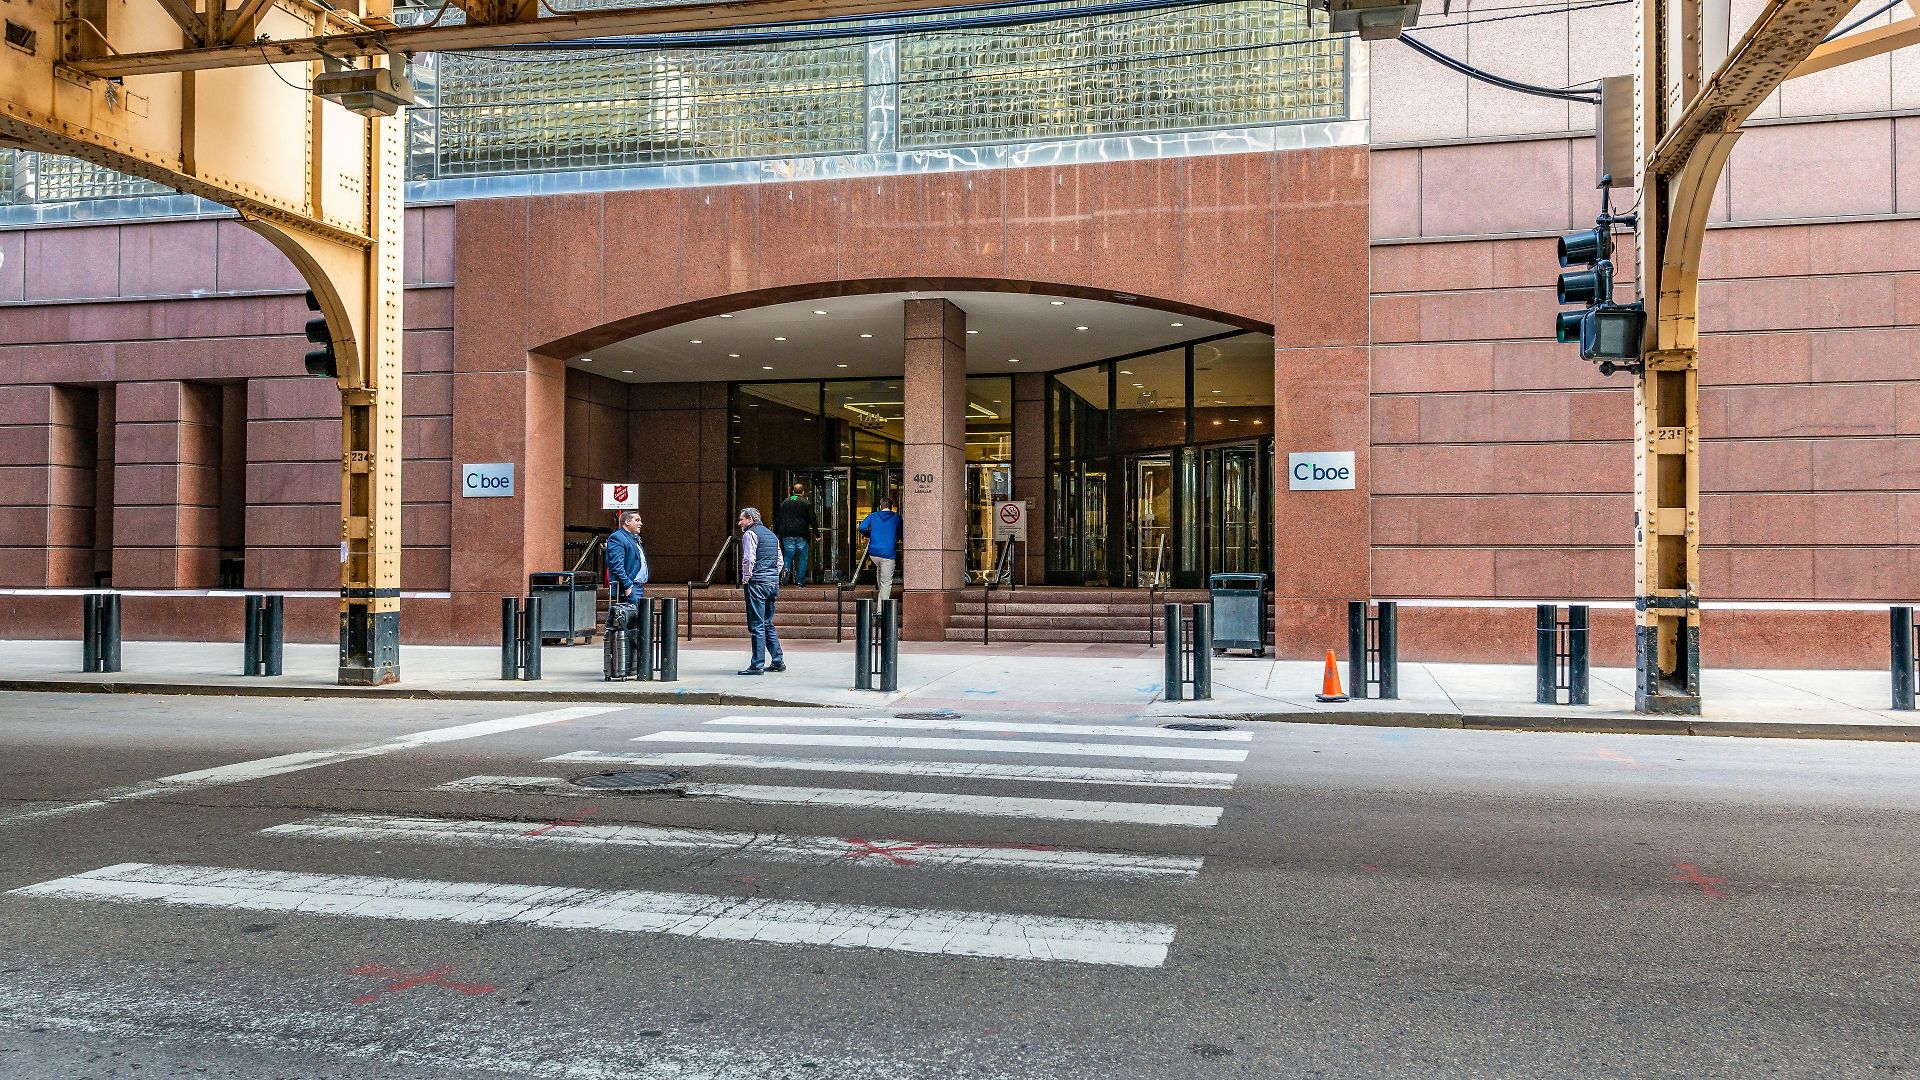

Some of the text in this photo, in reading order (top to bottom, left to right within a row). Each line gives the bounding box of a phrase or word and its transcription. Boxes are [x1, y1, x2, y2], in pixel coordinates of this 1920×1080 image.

[351, 452, 369, 462] 234
[913, 473, 934, 483] 400
[1294, 462, 1349, 481] Cboe
[466, 472, 510, 489] Cboe
